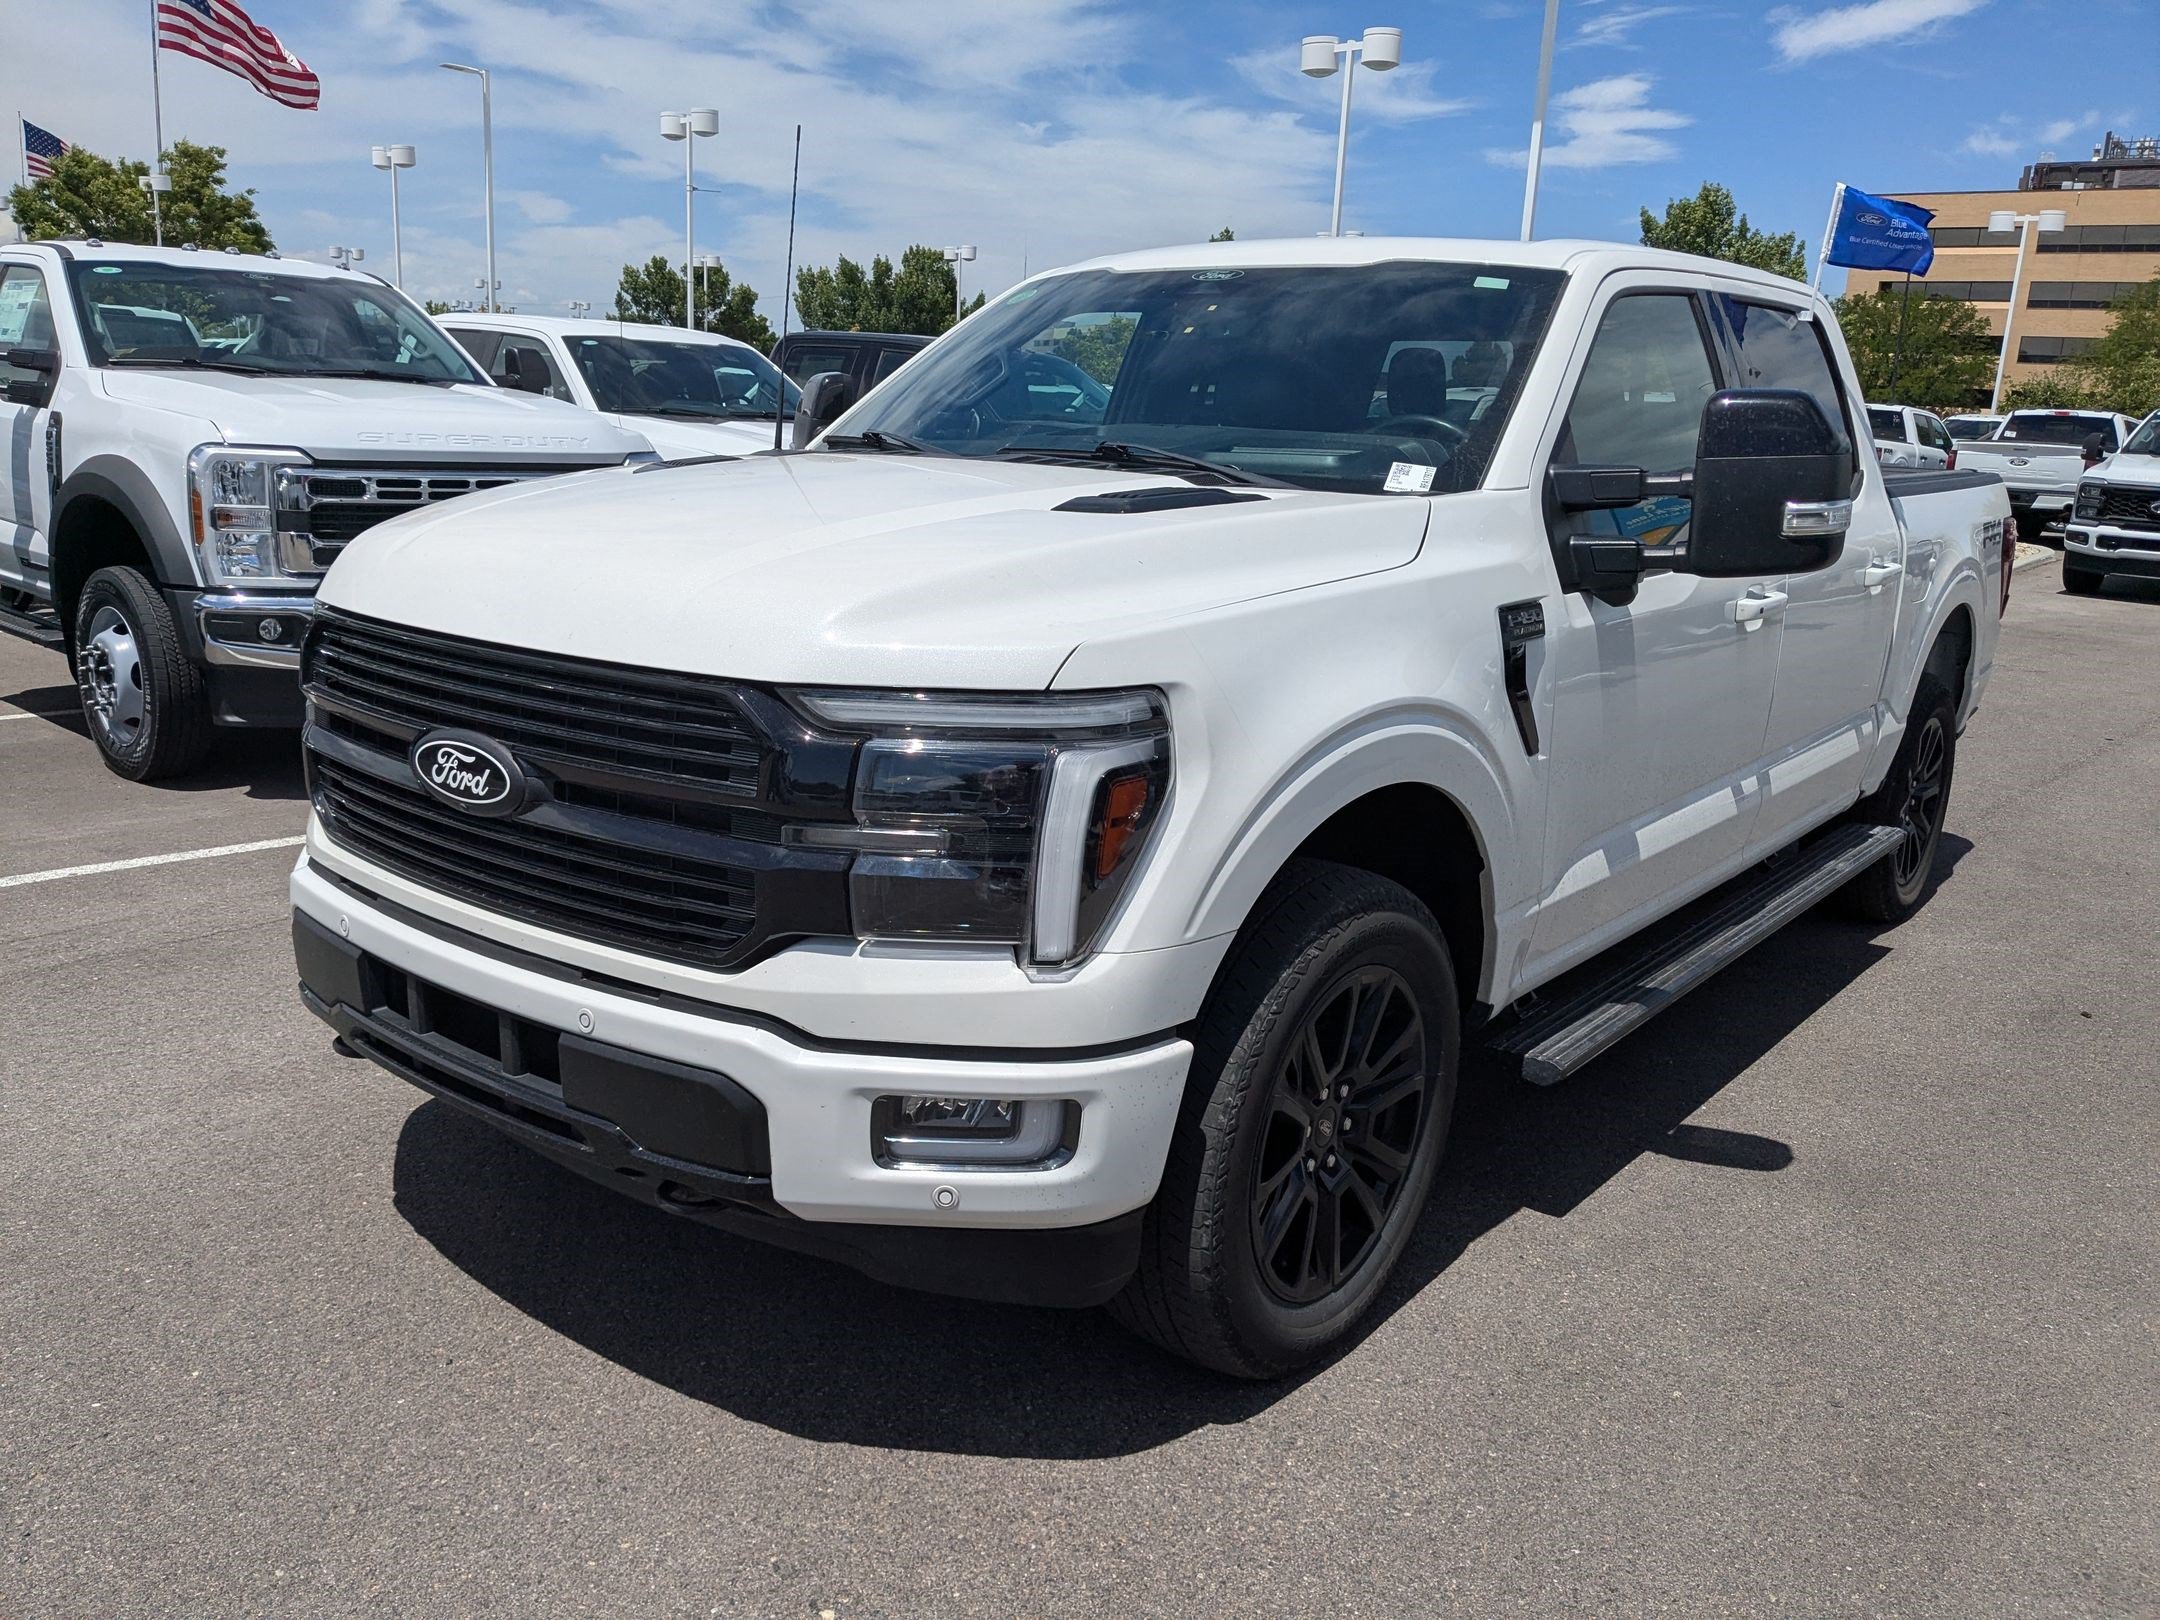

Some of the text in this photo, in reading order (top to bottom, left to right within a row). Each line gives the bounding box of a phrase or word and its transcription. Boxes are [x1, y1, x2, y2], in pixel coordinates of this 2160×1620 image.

[1860, 214, 1883, 225] Ford
[1890, 218, 1908, 229] Blue
[1886, 228, 1929, 241] Advantage
[1862, 237, 1888, 247] Certified
[1889, 242, 1905, 250] Used
[1199, 270, 1237, 279] Ford
[357, 431, 589, 449] SUPER DUTY
[1508, 609, 1543, 627] F-150
[1513, 623, 1543, 636] PLATINUM
[431, 747, 491, 796] Ford
